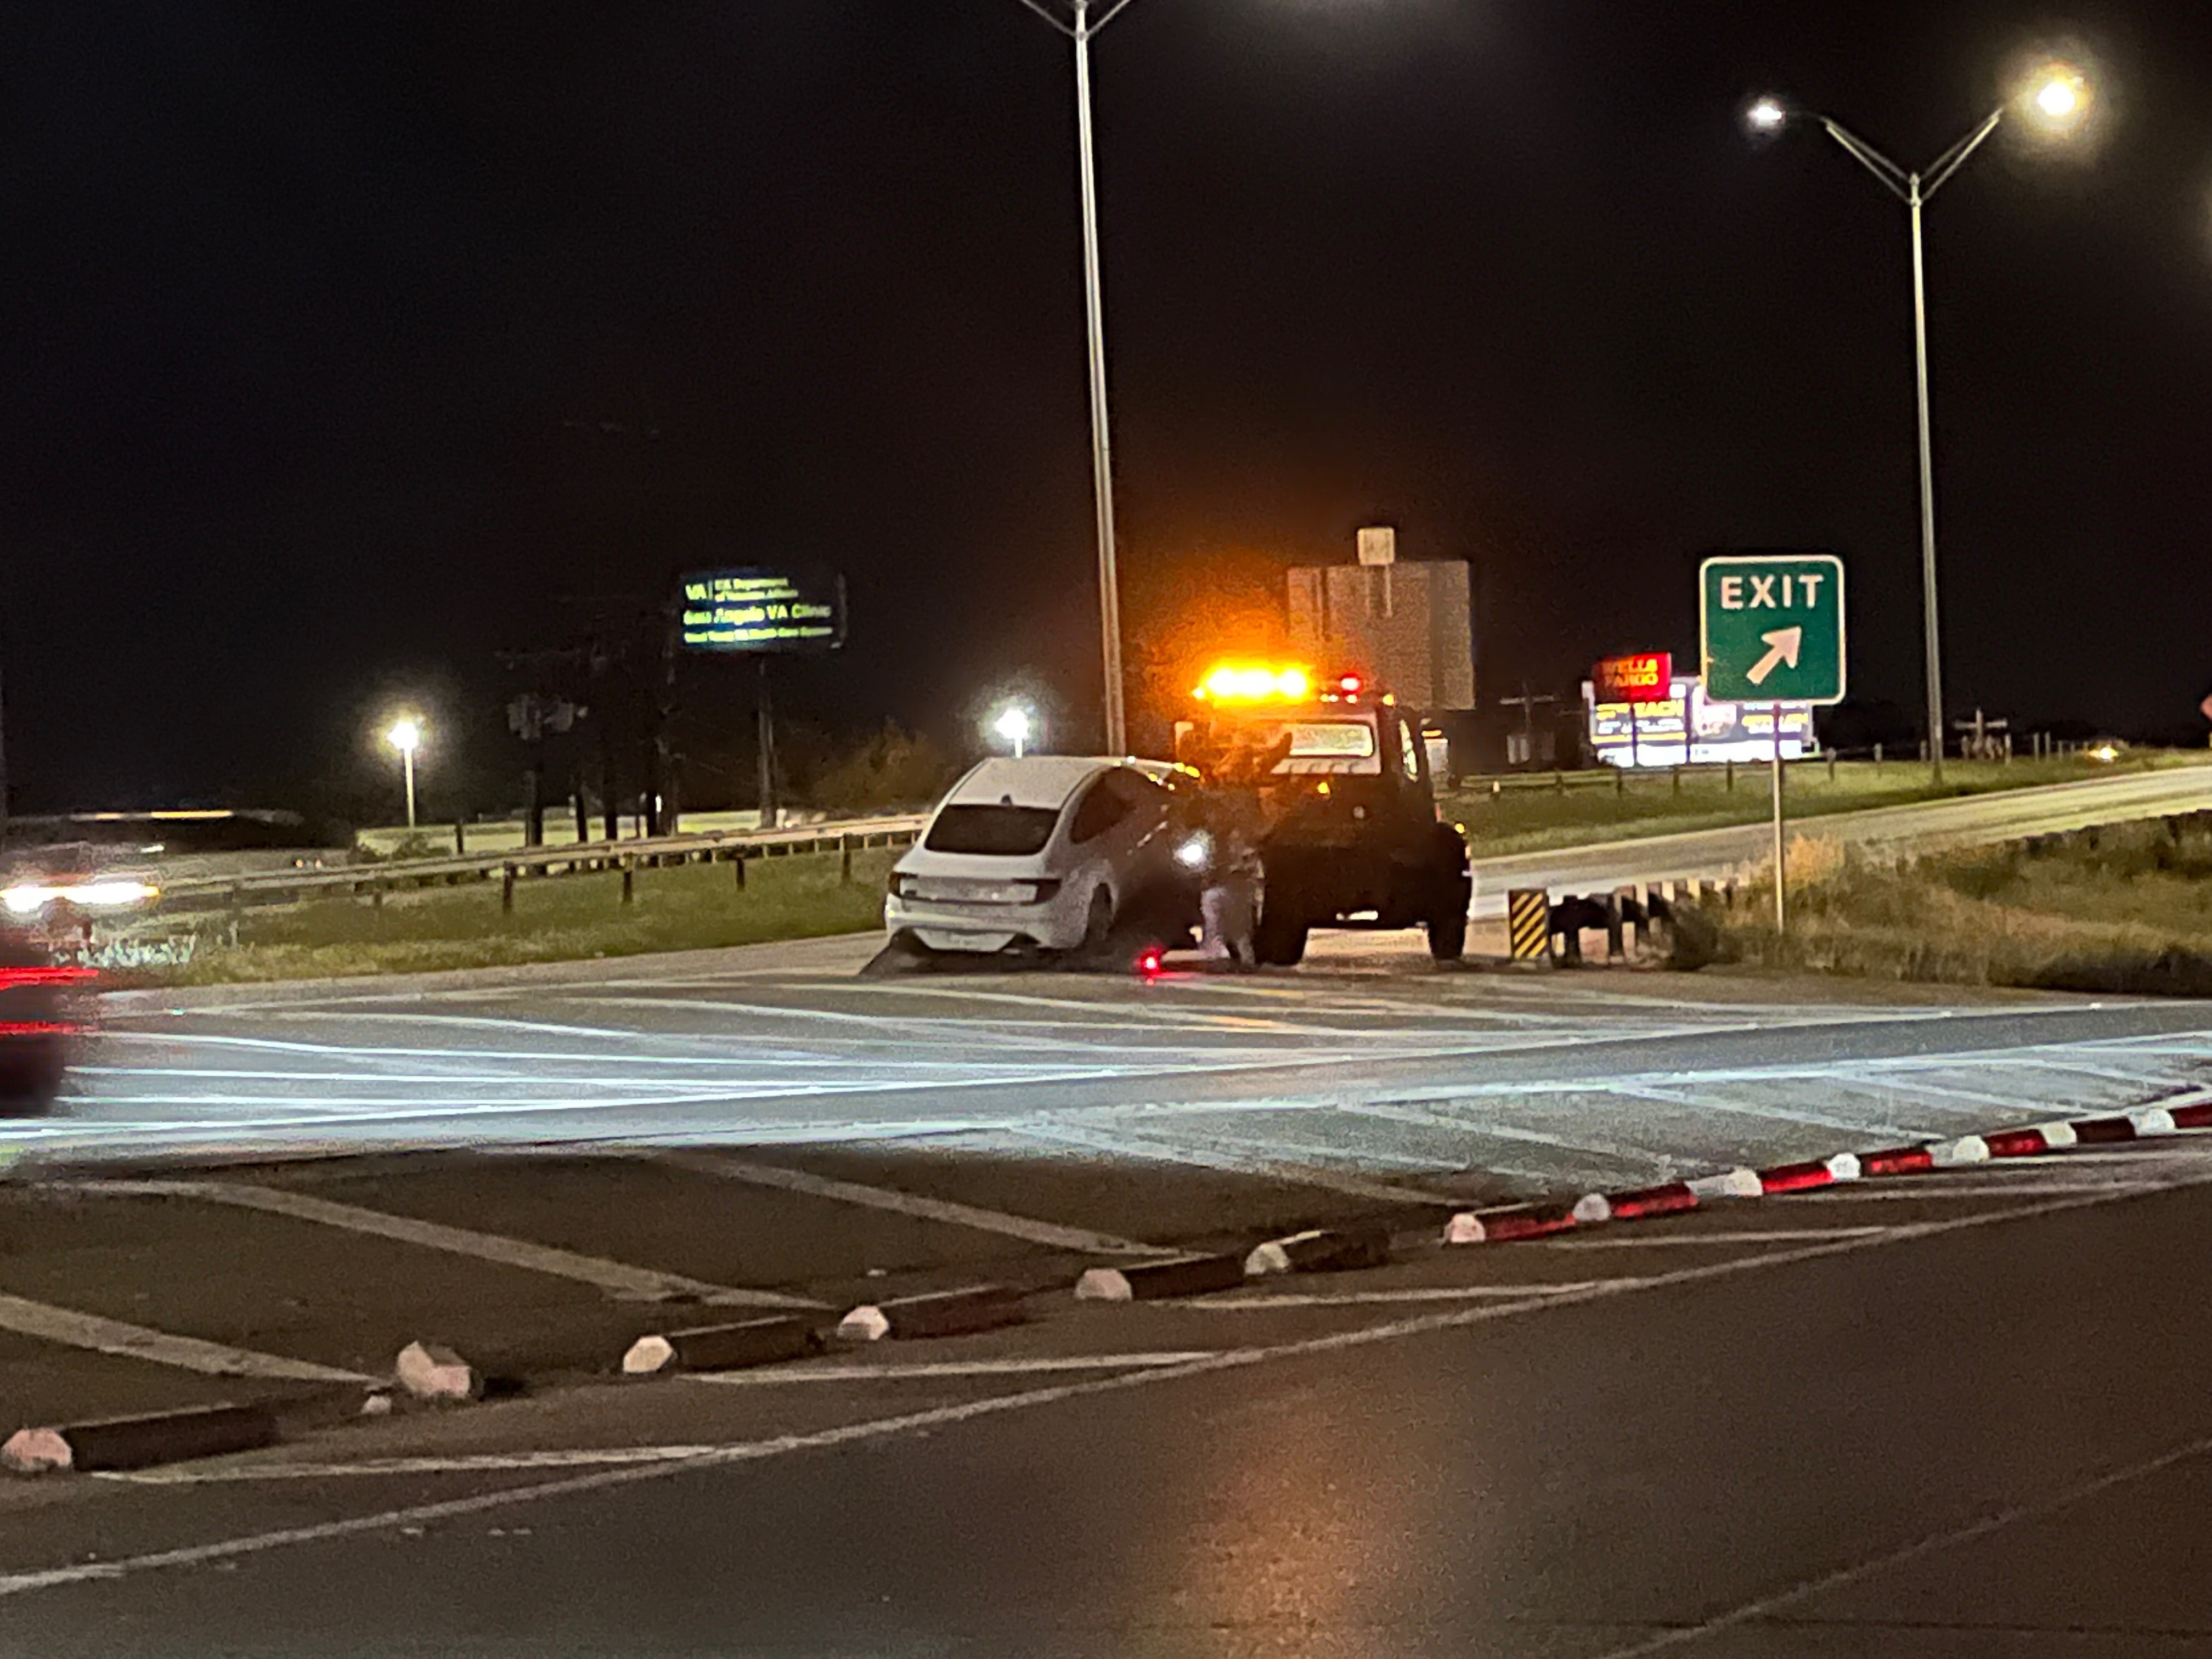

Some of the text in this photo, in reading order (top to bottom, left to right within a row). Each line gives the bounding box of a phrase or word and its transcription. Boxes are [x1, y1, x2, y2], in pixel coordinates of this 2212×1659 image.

[686, 584, 707, 600] VA
[1721, 574, 1824, 610] EXIT
[766, 605, 788, 619] VA
[1601, 659, 1658, 673] WELLS
